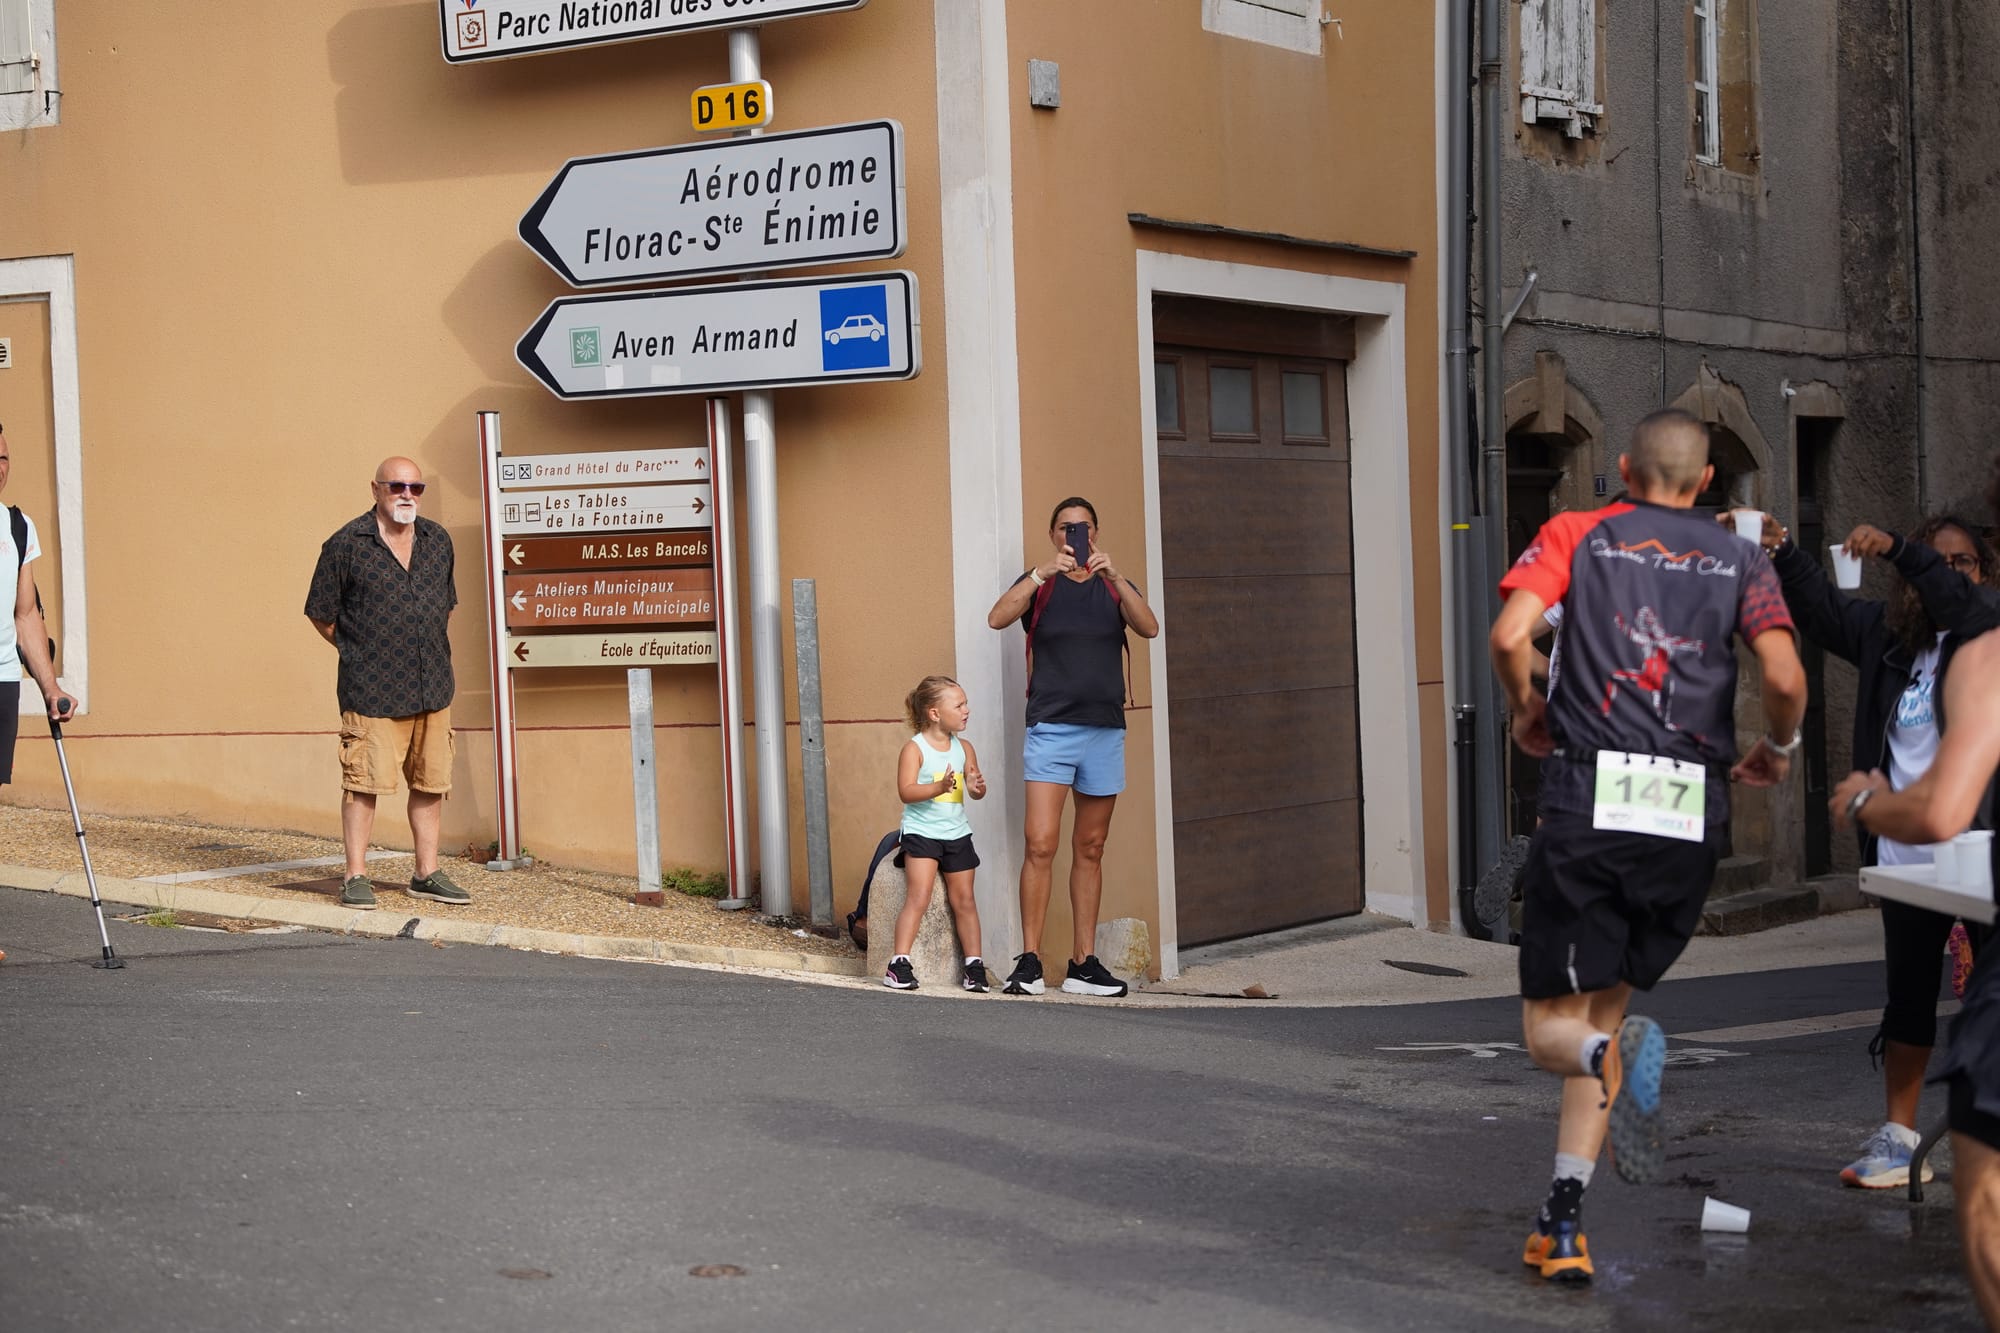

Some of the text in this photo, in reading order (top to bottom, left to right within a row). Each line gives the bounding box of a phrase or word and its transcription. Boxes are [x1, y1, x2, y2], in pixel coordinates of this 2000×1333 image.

[497, 0, 711, 40] Parc National des
[697, 90, 760, 124] D 16
[680, 156, 877, 204] Aérodrome
[763, 198, 879, 246] Énimie
[611, 319, 797, 359] Aven Armand
[535, 464, 571, 477] Grand
[577, 461, 609, 475] Hôtel
[615, 461, 629, 473] du
[545, 493, 627, 510] Les Tables
[546, 510, 664, 528] de la Fontaine
[582, 540, 709, 560] M.A.S. Les Bancels
[535, 579, 674, 598] Ateliers Municipaux
[535, 598, 711, 618] Police Rurale Municipale
[601, 638, 712, 660] École d'Équitation
[1615, 774, 1689, 810] 147
